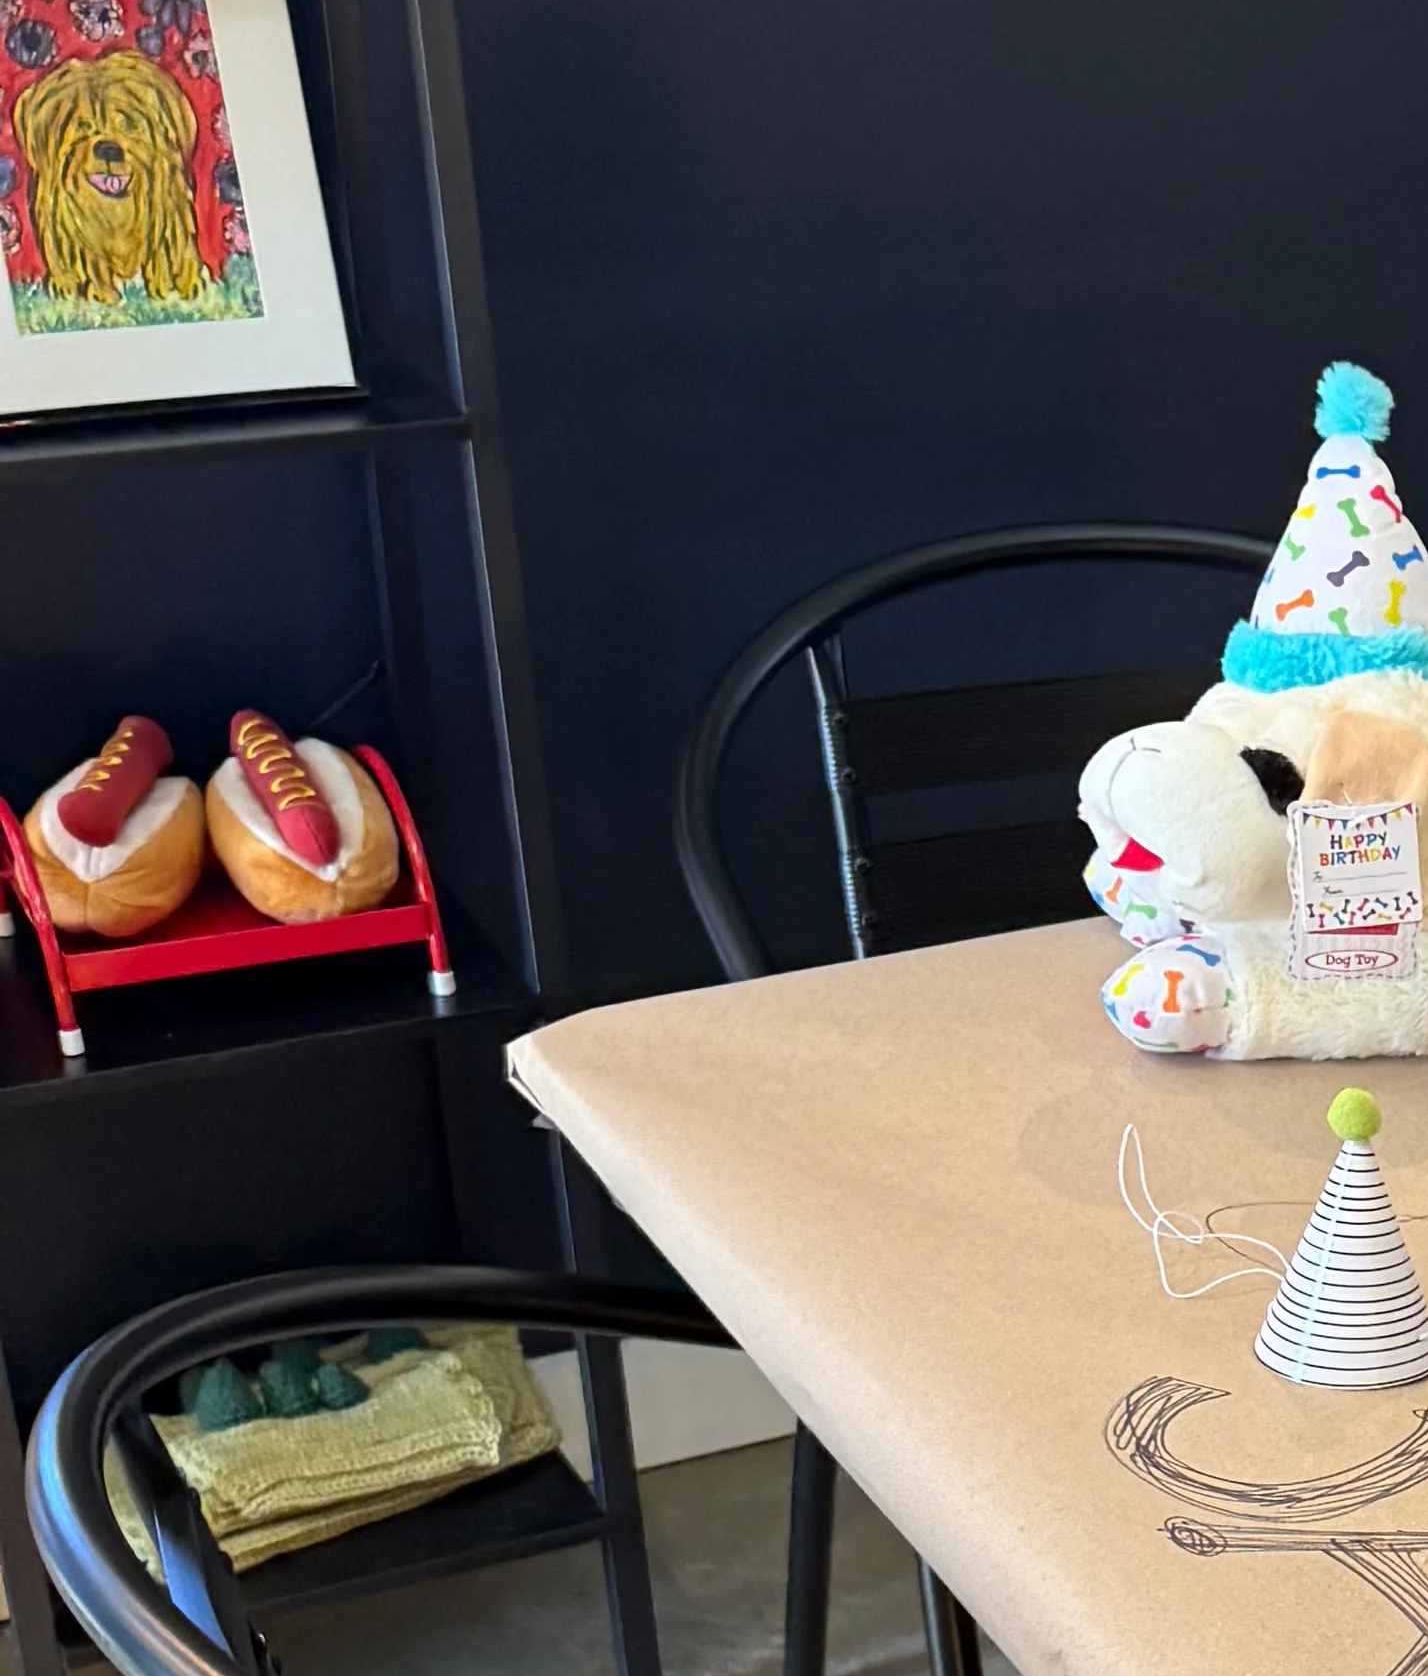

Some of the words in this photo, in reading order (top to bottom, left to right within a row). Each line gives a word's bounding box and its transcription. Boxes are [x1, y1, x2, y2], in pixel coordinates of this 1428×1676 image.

[1329, 831, 1388, 851] HAPPY
[1319, 845, 1401, 867] BIRTHDAY
[1325, 954, 1351, 968] Dog
[1355, 954, 1380, 967] Toy
